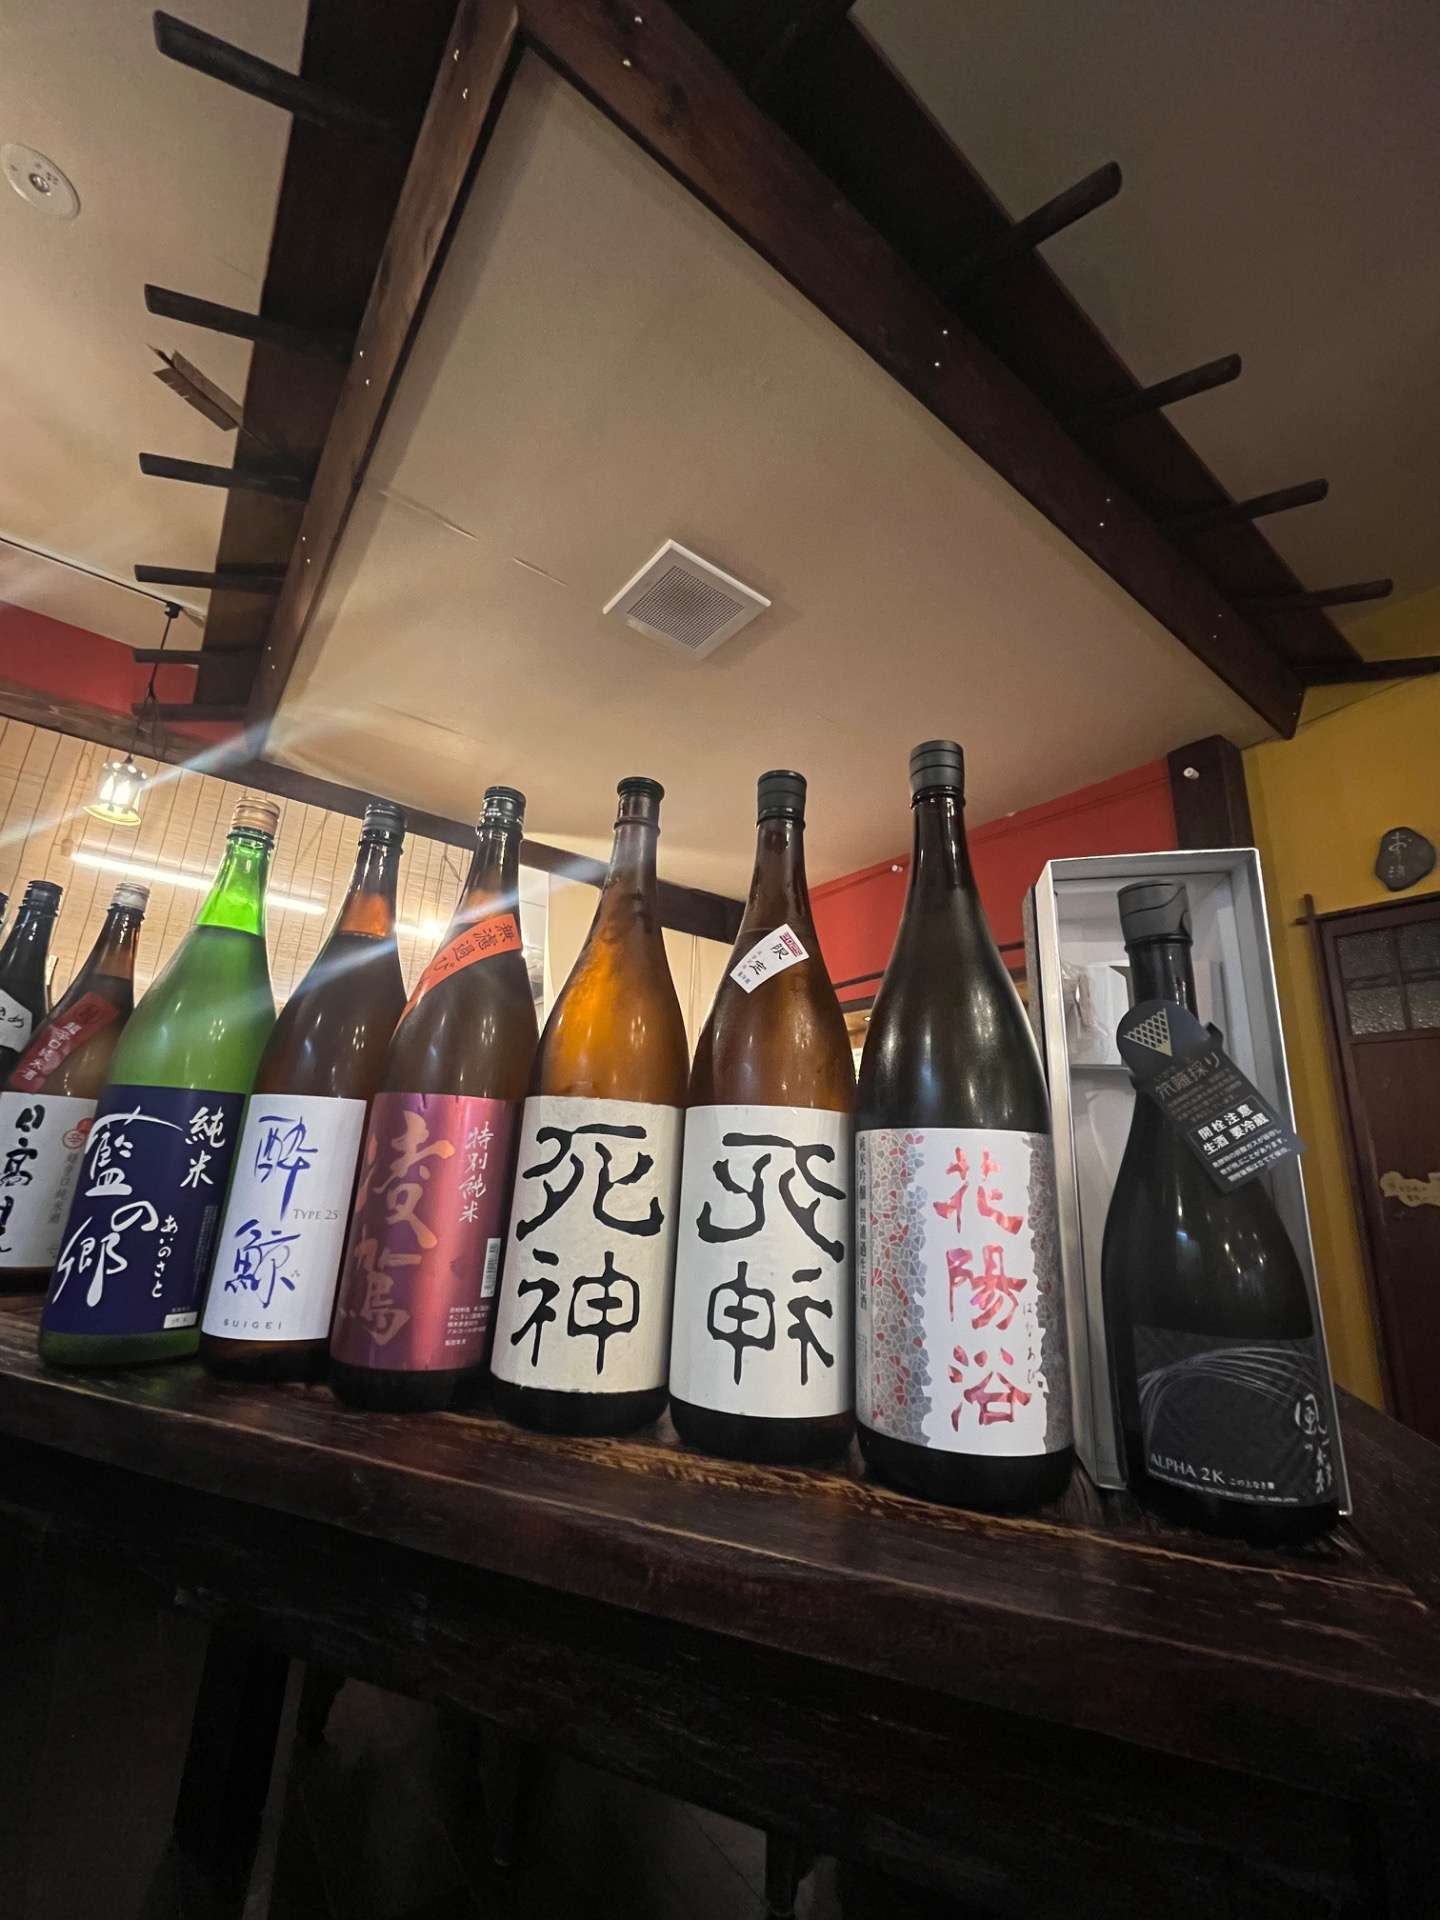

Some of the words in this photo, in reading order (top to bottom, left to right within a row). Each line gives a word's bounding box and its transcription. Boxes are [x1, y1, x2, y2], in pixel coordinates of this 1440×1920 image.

[749, 943, 791, 976] 限定
[180, 1106, 226, 1189] 純米
[1198, 1103, 1253, 1141] 開栓注意
[1203, 1134, 1230, 1156] 生酒
[1228, 1112, 1271, 1140] 要冷蔵
[52, 1105, 184, 1309] 藍の郷
[224, 1116, 318, 1310] 酔鯨
[293, 1208, 322, 1221] TYPE
[324, 1208, 340, 1221] 25
[458, 1121, 495, 1225] 特別純米
[151, 1214, 179, 1299] あいのさと
[511, 1124, 662, 1377] 死神
[933, 1147, 1032, 1433] 花陽浴
[223, 1317, 284, 1331] SUIGEI
[1151, 1452, 1199, 1479] ALPHA
[1200, 1467, 1225, 1485] 2K
